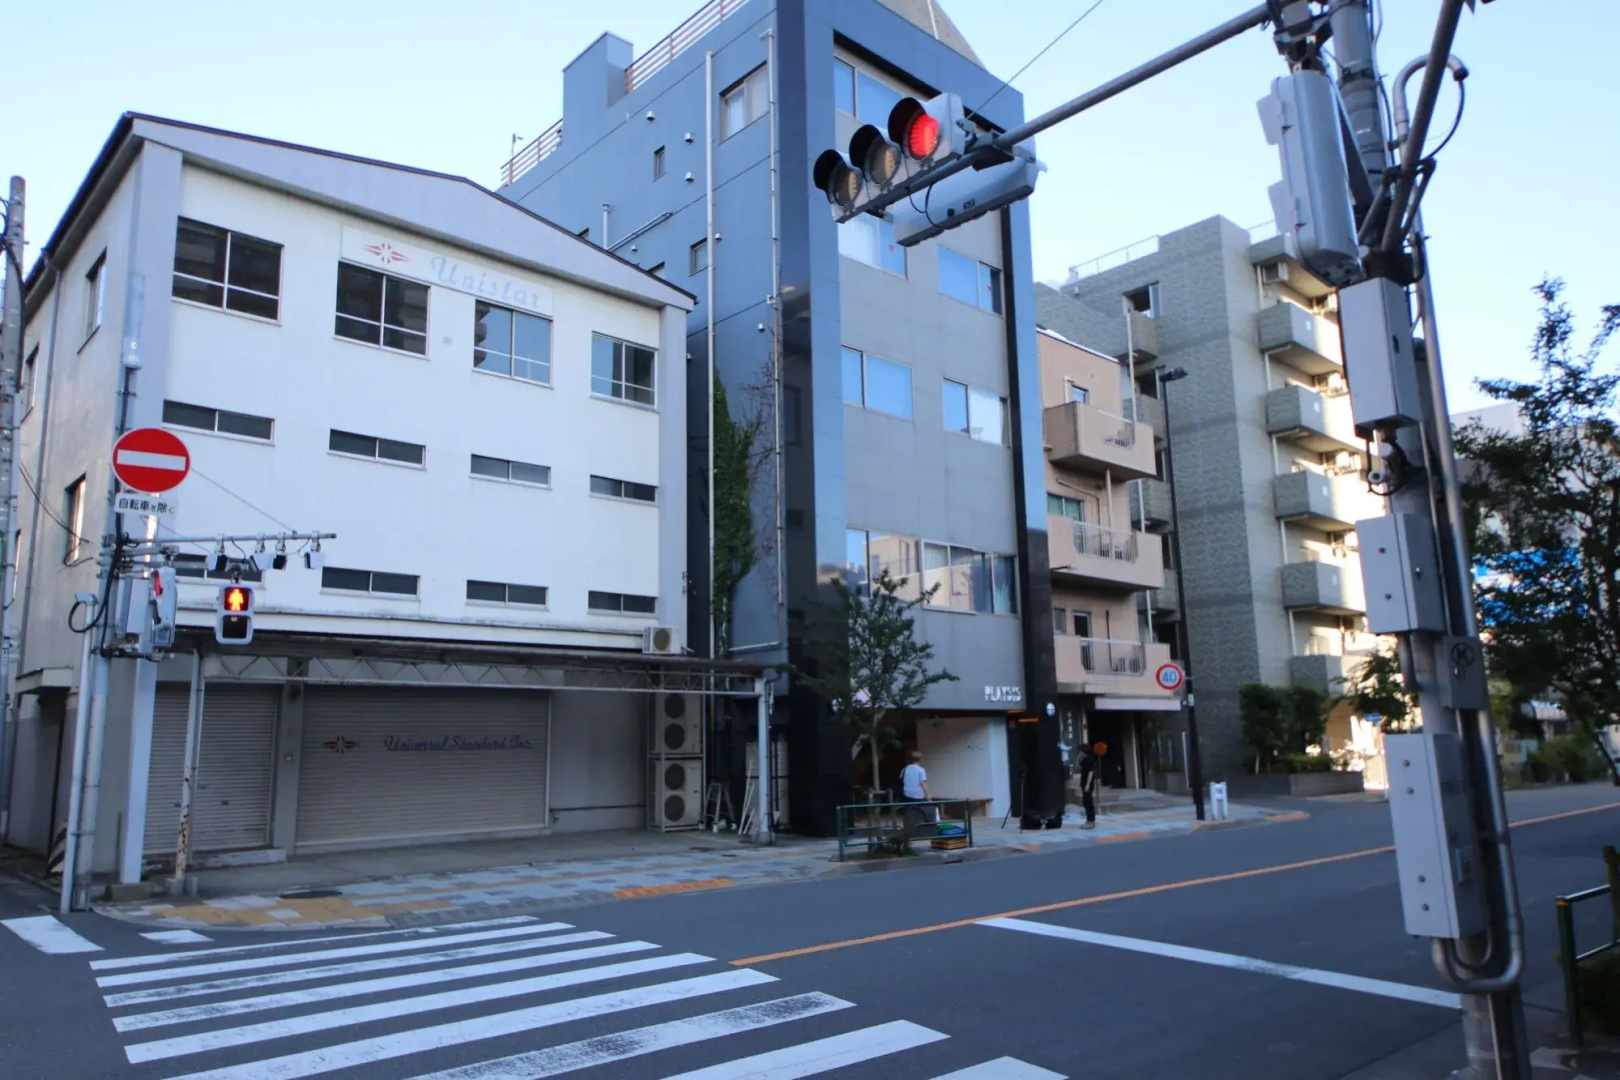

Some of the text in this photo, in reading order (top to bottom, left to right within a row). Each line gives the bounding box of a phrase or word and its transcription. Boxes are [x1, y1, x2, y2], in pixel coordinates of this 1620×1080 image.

[430, 256, 540, 309] Unistar
[1162, 671, 1177, 683] 40
[451, 734, 508, 750] Standard
